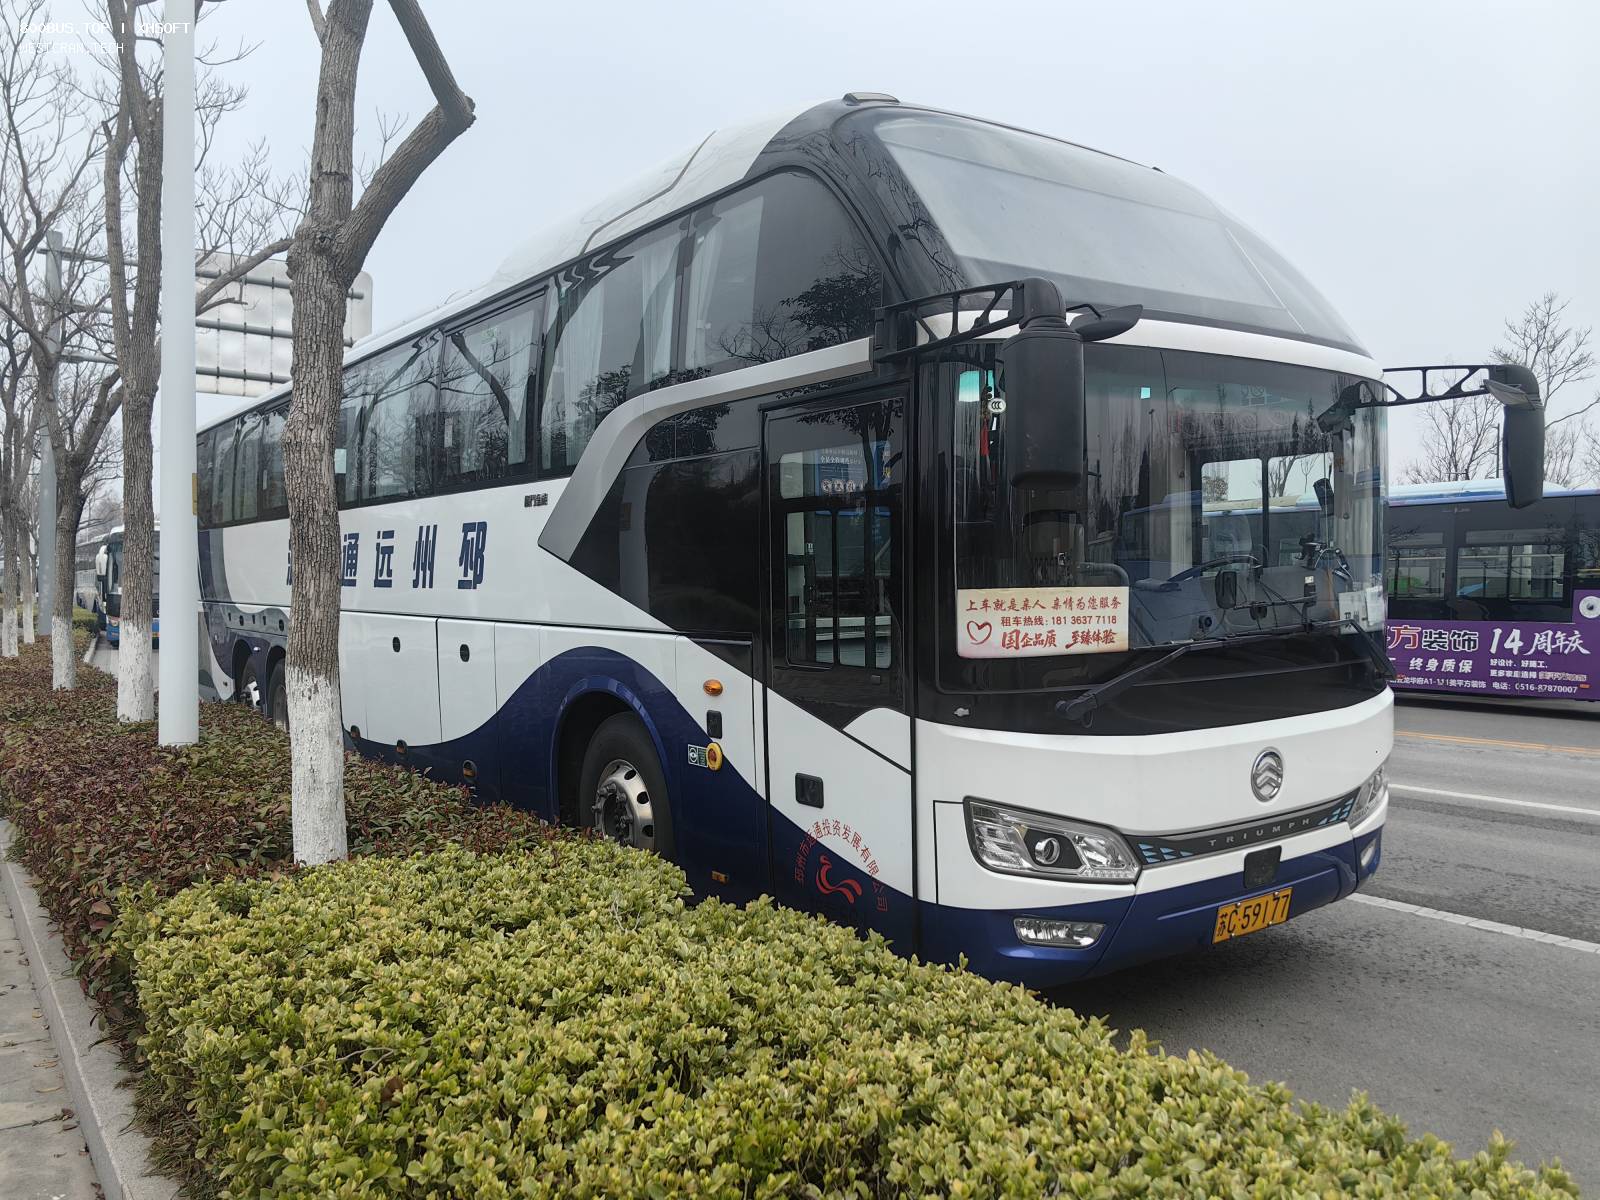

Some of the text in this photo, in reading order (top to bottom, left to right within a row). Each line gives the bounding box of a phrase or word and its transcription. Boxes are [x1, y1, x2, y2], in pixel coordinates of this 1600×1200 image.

[1051, 616, 1067, 625] 181
[1070, 615, 1093, 625] 3637
[1096, 615, 1117, 625] 7118
[1002, 628, 1118, 650] 国企品质 至臻体验
[1386, 624, 1479, 652] 方装饰
[1409, 657, 1473, 674] 终身质保
[1208, 818, 1311, 847] TRIUMPH
